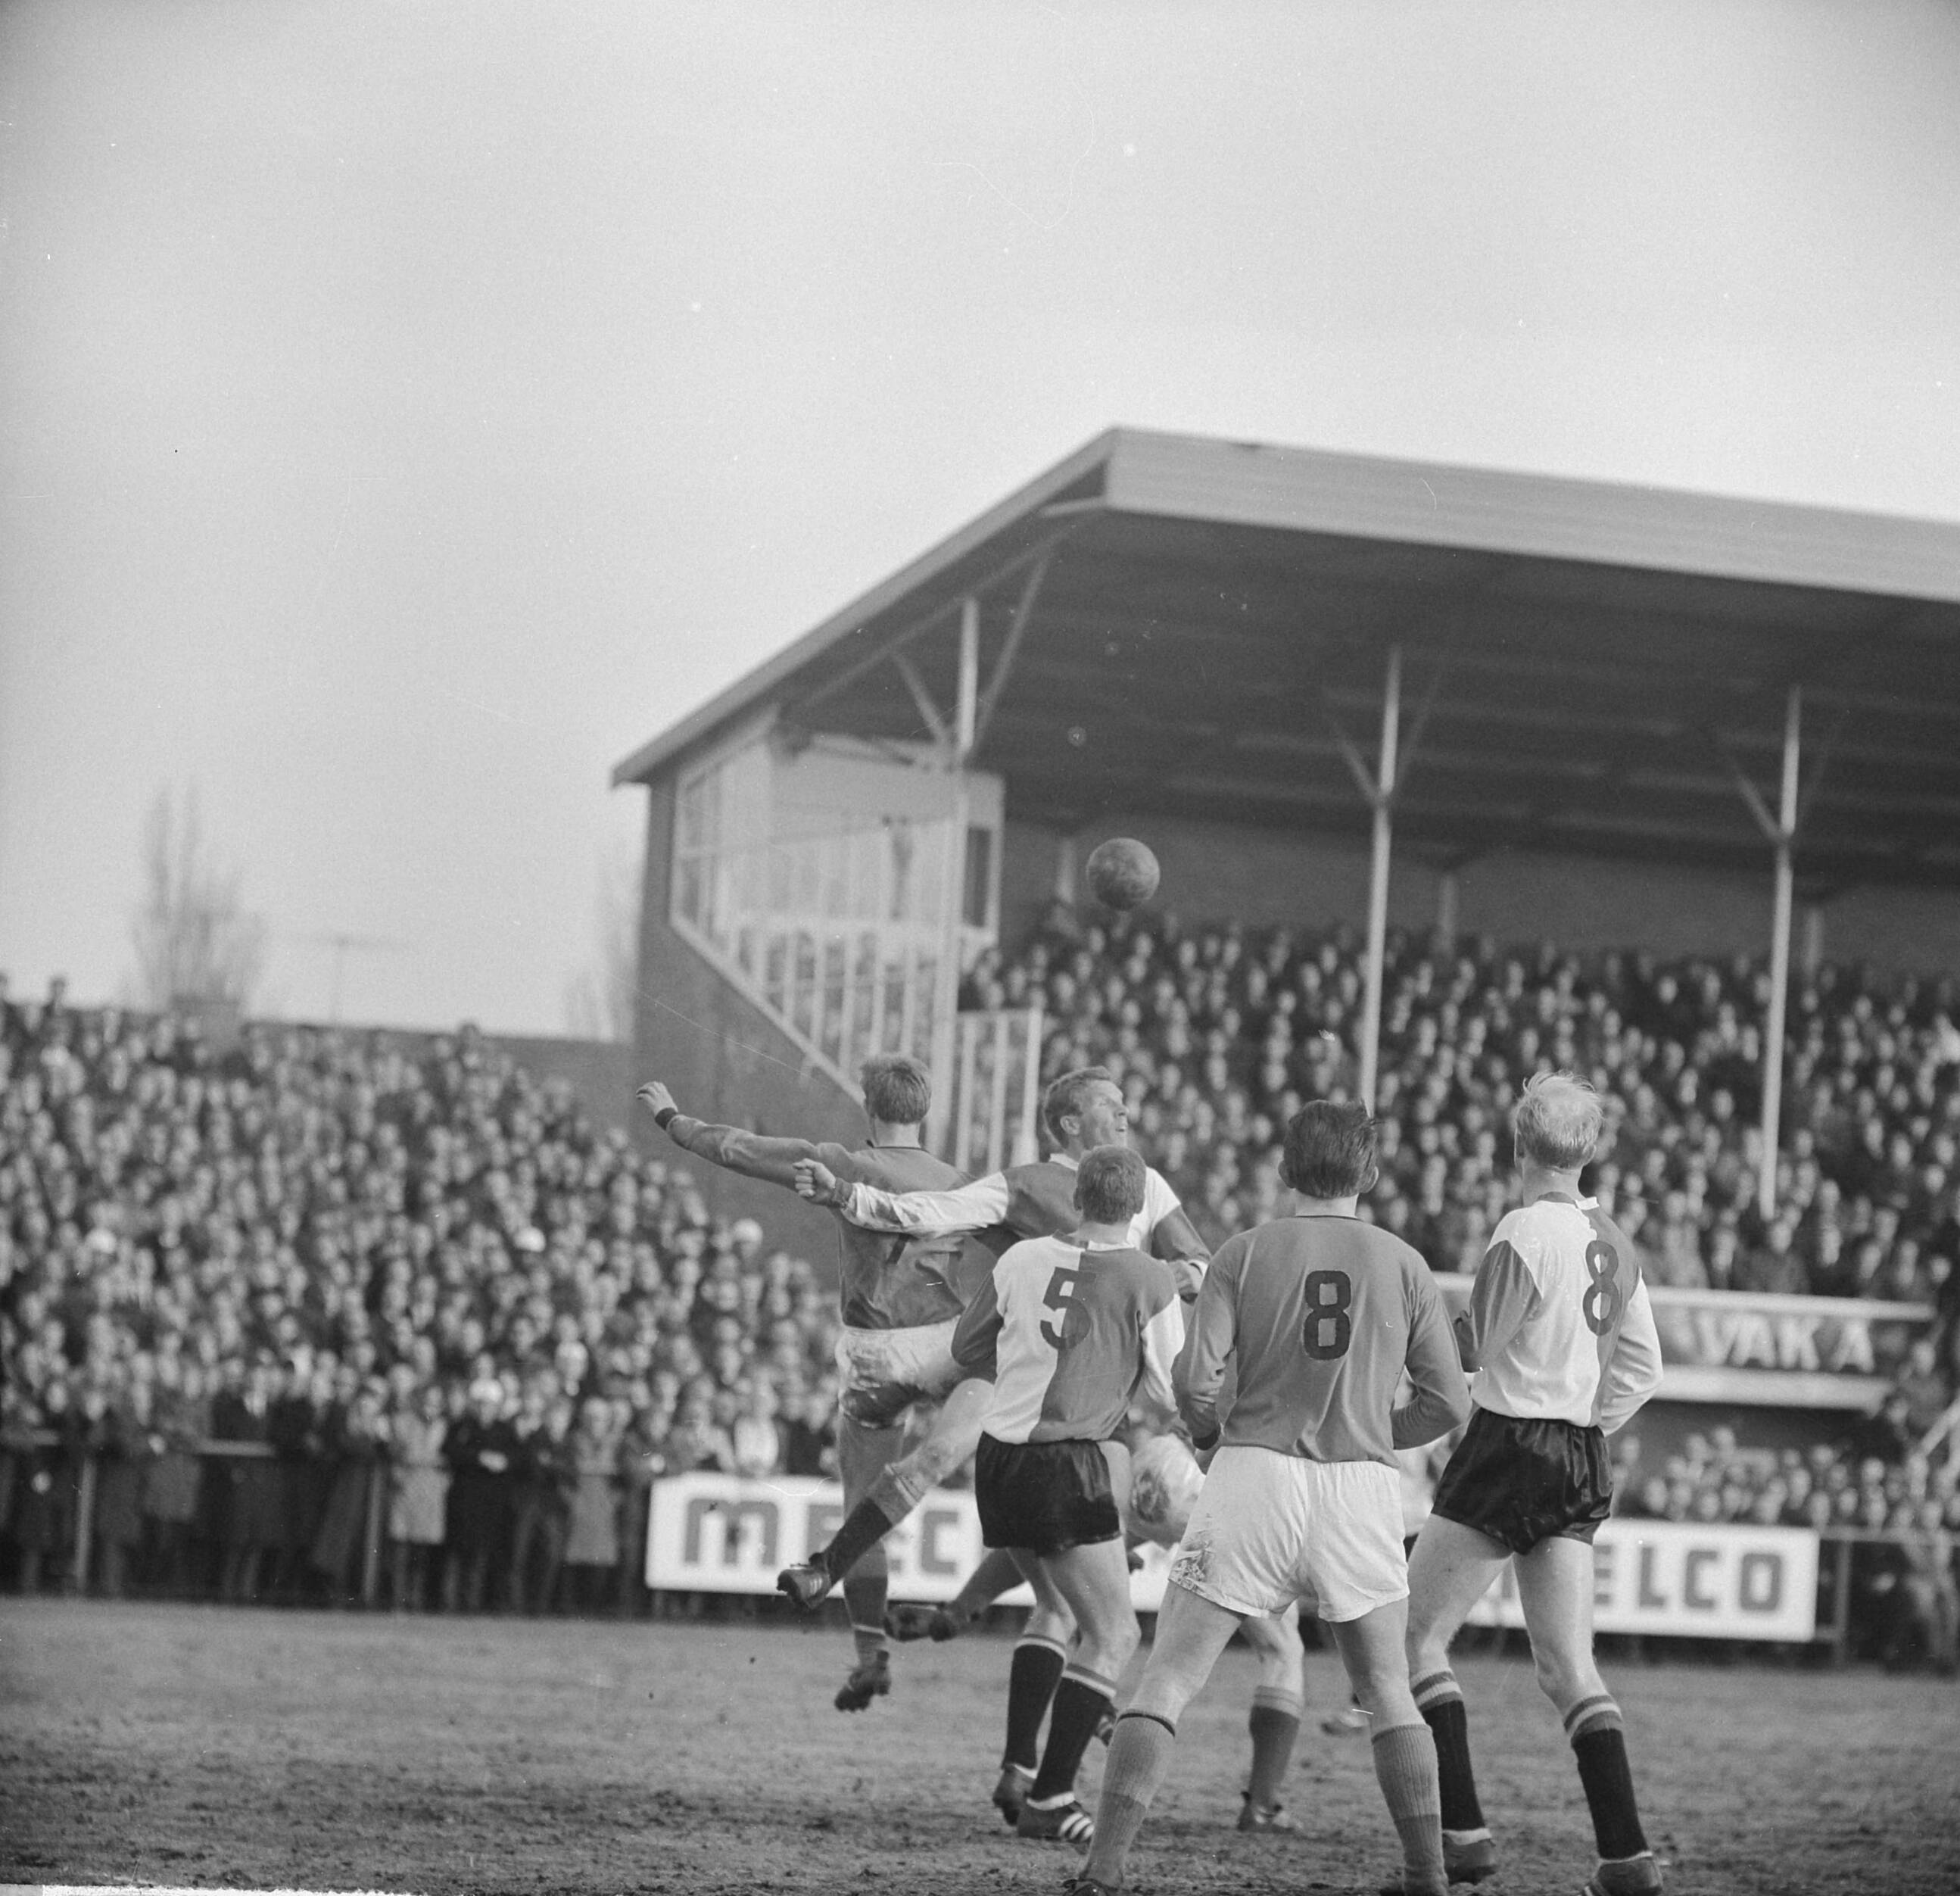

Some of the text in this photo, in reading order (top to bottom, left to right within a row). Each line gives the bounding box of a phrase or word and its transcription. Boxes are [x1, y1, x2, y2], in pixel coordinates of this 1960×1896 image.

[1039, 1266, 1097, 1351] 5
[1303, 1269, 1351, 1361] 8
[1582, 1239, 1621, 1336] 8
[684, 1497, 959, 1575] MEC
[1502, 1543, 1784, 1613] ELCO
